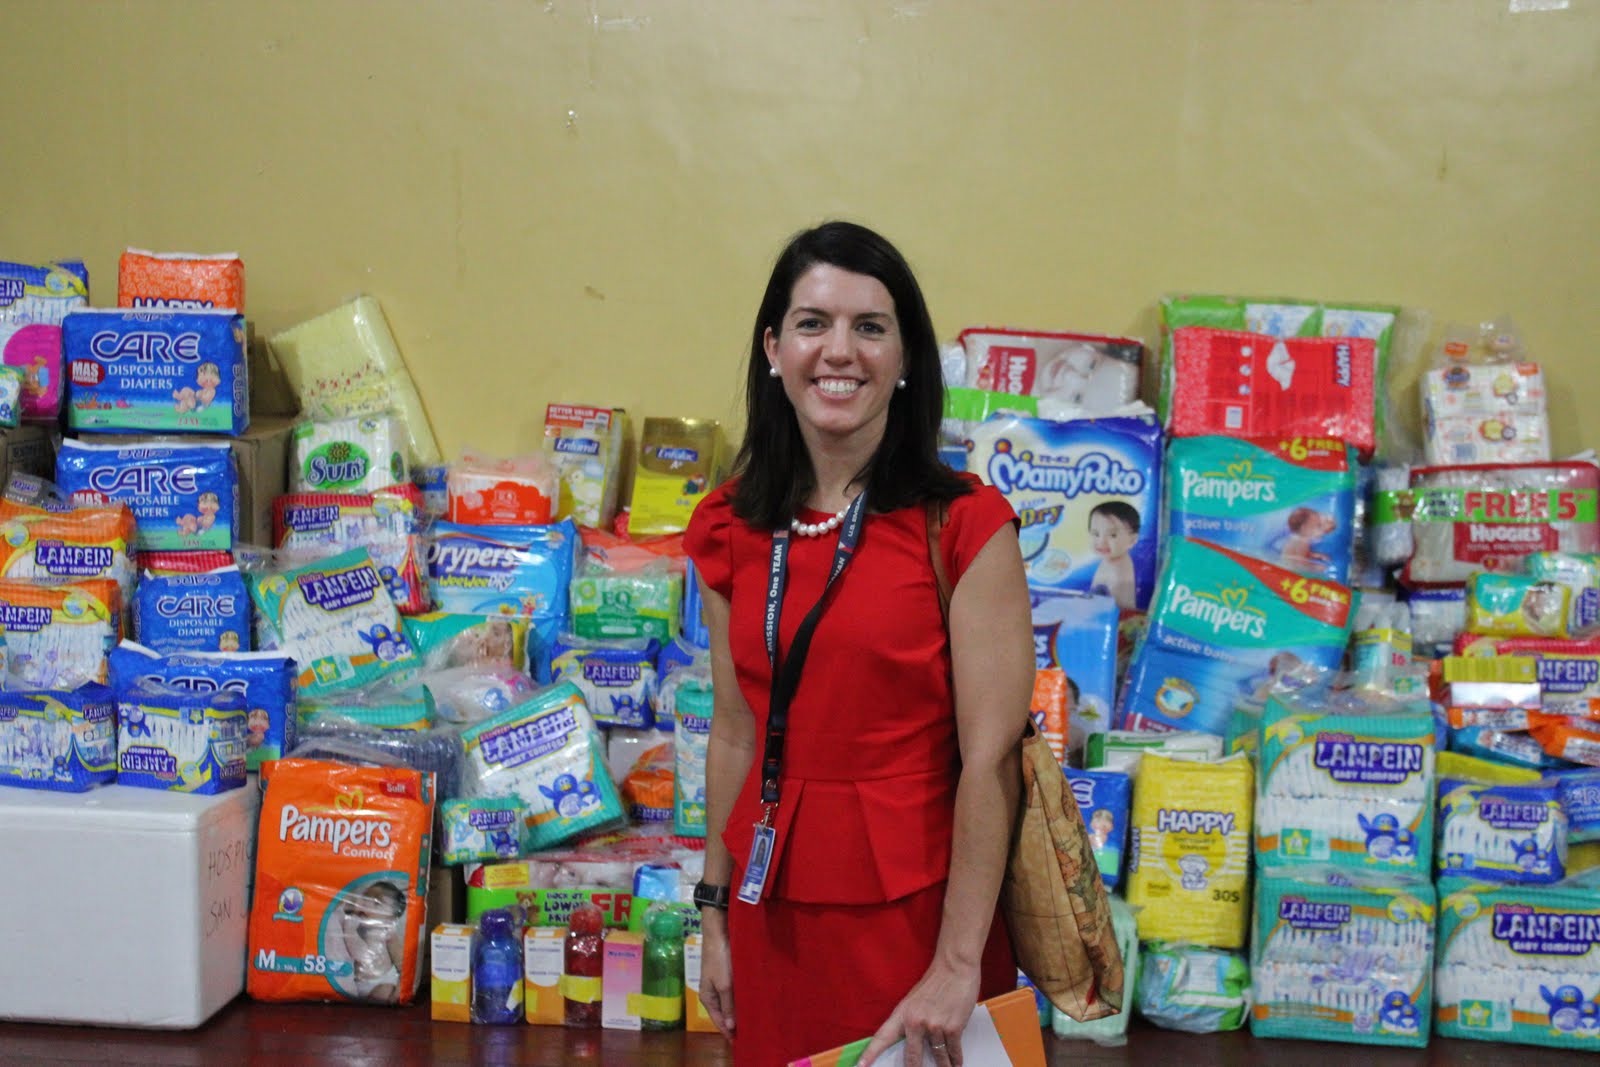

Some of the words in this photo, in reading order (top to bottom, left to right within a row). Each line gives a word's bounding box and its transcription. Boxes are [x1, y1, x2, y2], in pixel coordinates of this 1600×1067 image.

[90, 331, 201, 363] CARE
[72, 361, 99, 377] MAS
[108, 365, 184, 376] DISPOSABLE
[121, 378, 173, 389] DIAPERS
[89, 465, 198, 495] CARE
[989, 450, 1145, 499] MamyPoko
[1182, 470, 1276, 507] Pampers
[286, 507, 338, 523] LAMPEIN
[1020, 505, 1064, 528] Dry
[1464, 491, 1550, 519] FREE
[1557, 491, 1578, 520] 5
[37, 546, 112, 566] LAMPEIN
[772, 544, 783, 574] TEAM
[302, 565, 378, 603] LAMPEIN
[769, 575, 779, 598] One
[0, 606, 51, 624] AMPEIN
[157, 595, 236, 617] CARE
[1169, 584, 1267, 639] Pampers
[169, 619, 224, 627] DISPOSABLE
[178, 628, 216, 637] DIAPERS
[1163, 634, 1201, 653] active
[584, 663, 640, 681] LAMPEIN
[481, 706, 578, 762] LAMPEIN
[121, 753, 177, 773] LAMPEIN
[1316, 743, 1421, 770] LAMPEIN
[1158, 809, 1235, 835] HAPPY
[1480, 802, 1548, 822] LAMPEIN
[279, 804, 392, 854] Pampers
[342, 845, 395, 861] Comfort
[591, 893, 633, 922] FR
[1280, 902, 1350, 920] LAMPEIN
[1494, 913, 1600, 939] LAMPEIN
[258, 948, 276, 970] M
[303, 954, 327, 973] 58
